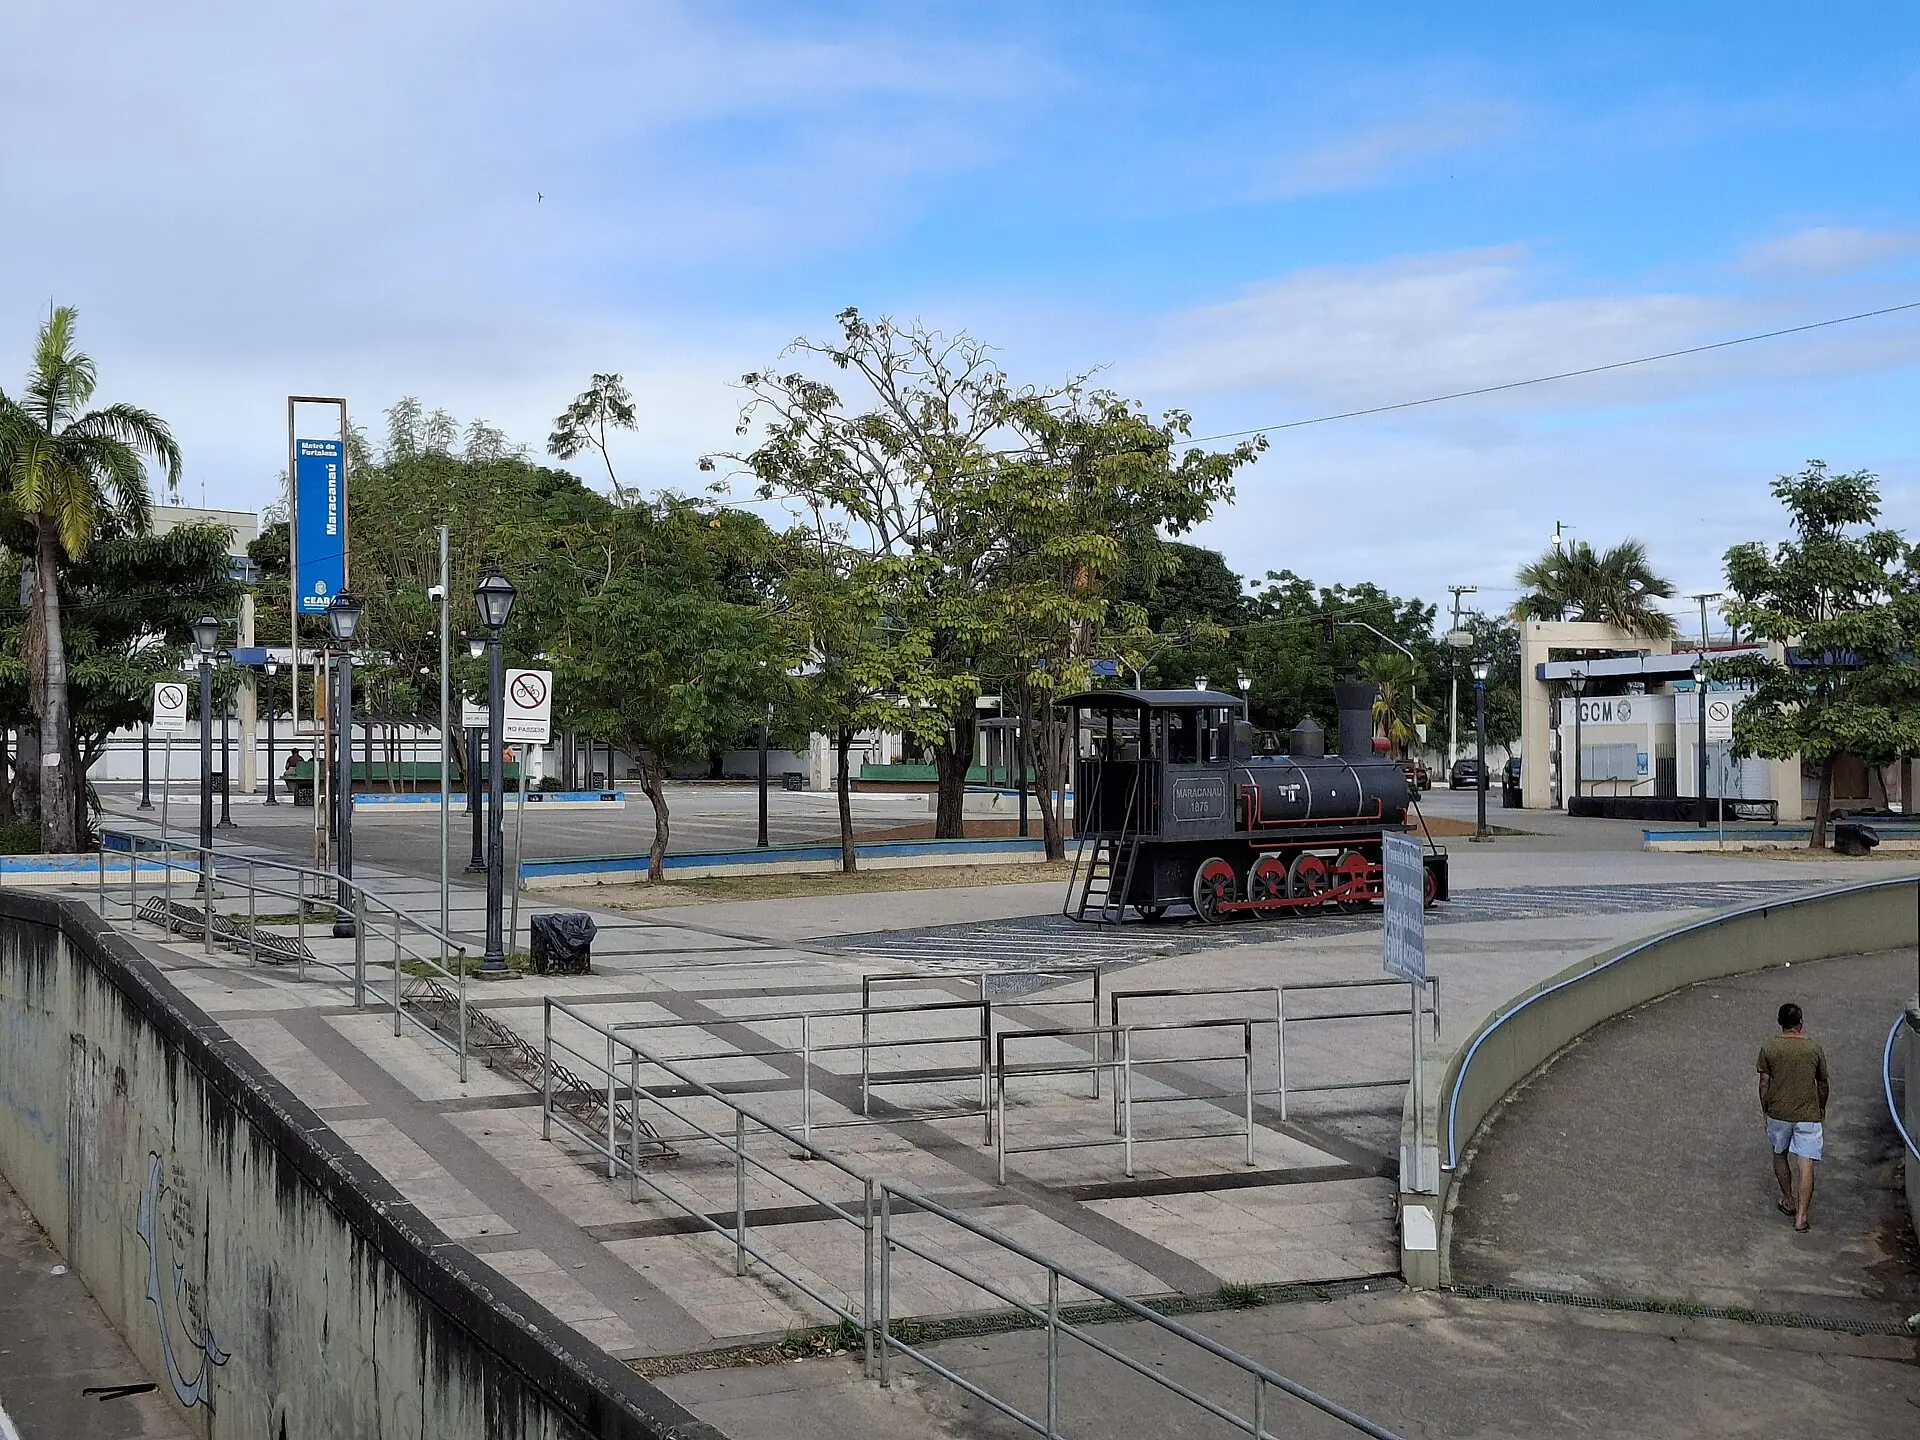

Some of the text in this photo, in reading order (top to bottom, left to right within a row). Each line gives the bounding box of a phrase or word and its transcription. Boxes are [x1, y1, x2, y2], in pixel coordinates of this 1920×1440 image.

[302, 449, 338, 457] Fortaleza
[326, 463, 337, 536] Maracanaú
[1580, 701, 1613, 722] GCM
